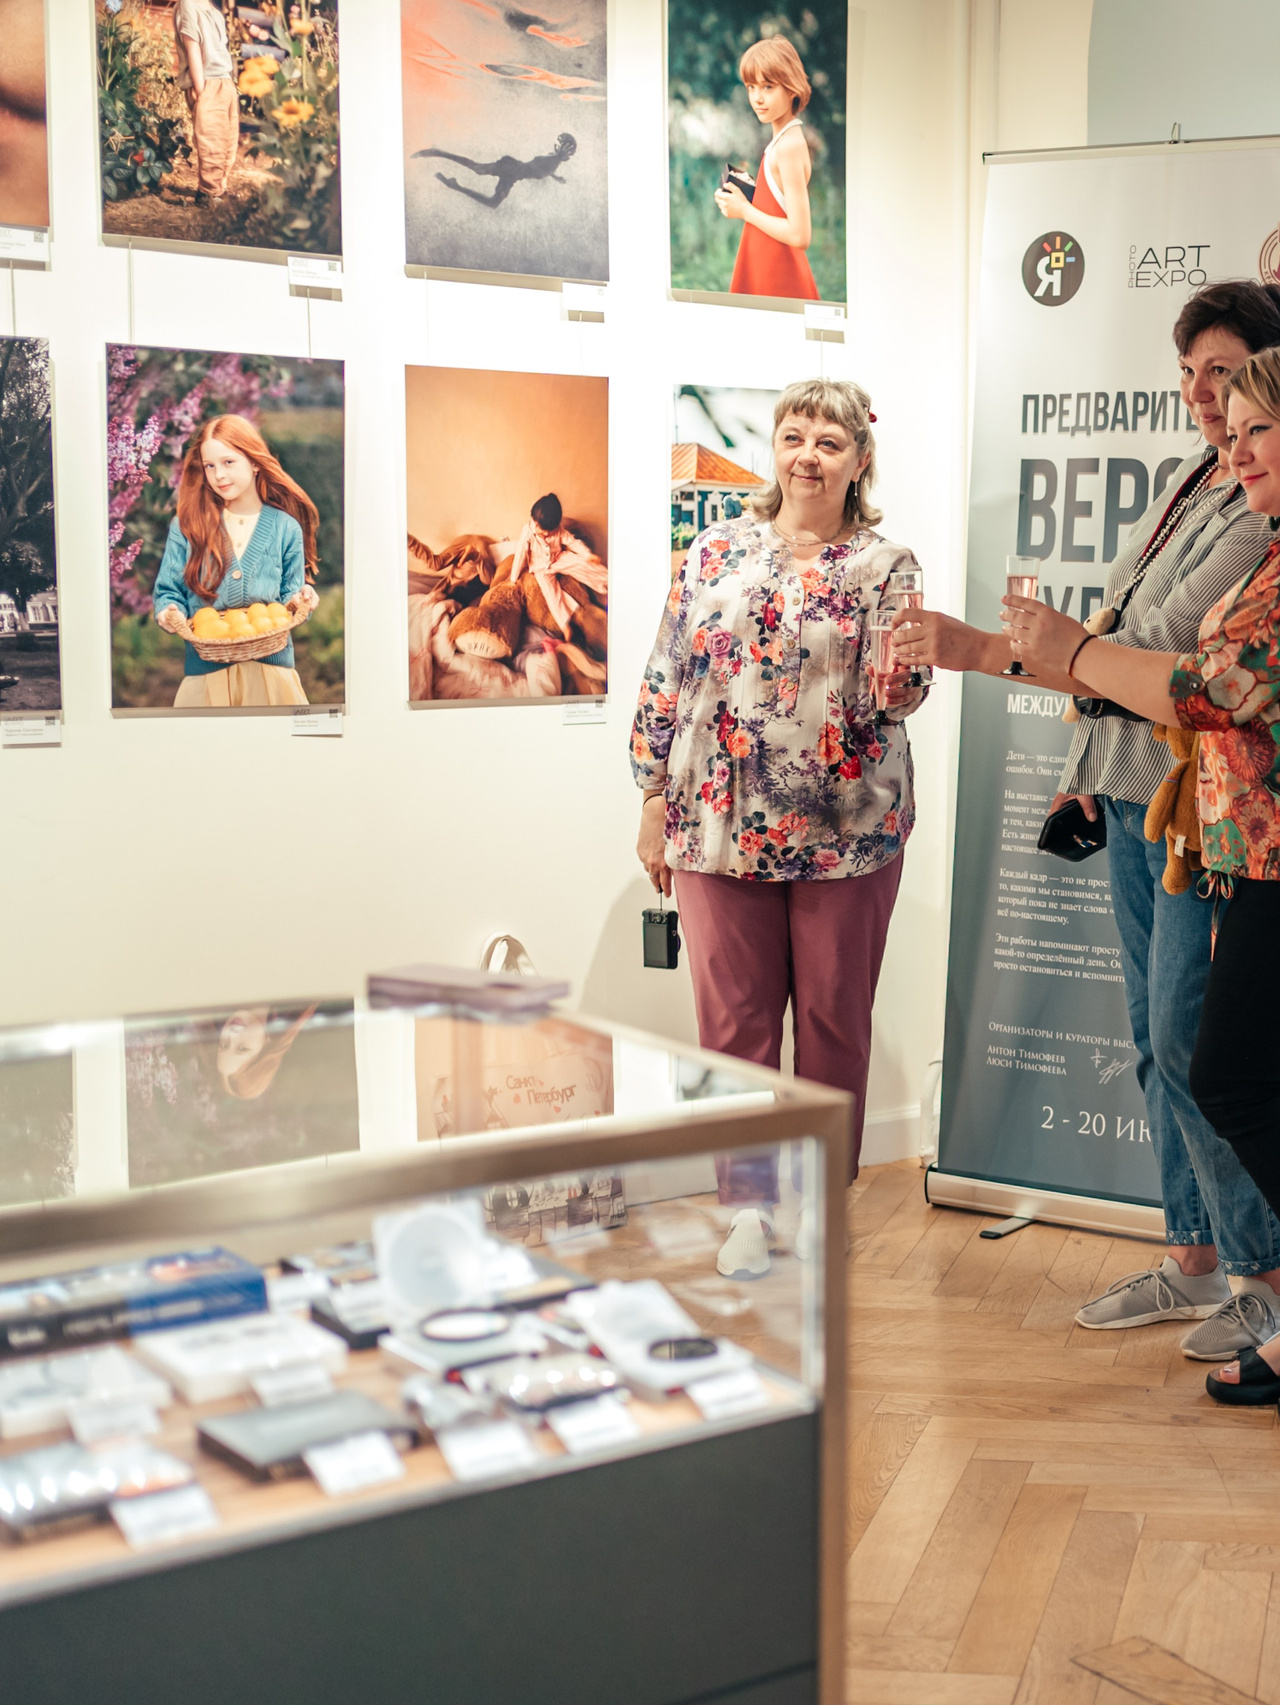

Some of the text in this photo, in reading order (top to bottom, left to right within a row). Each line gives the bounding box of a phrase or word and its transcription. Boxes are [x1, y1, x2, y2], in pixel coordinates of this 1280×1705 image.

[1128, 245, 1137, 288] PHOTO
[1137, 245, 1211, 270] ART
[1135, 269, 1207, 288] EXPO
[1006, 750, 1025, 761] Дети
[1036, 754, 1048, 762] это
[1006, 765, 1035, 775] ошибок.
[1037, 766, 1052, 776] Они
[1004, 789, 1015, 799] На
[1004, 805, 1030, 814] момент
[1002, 828, 1018, 839] Есть
[1000, 868, 1028, 880] Каждый
[1030, 872, 1047, 884] кадр
[1061, 876, 1074, 884] это
[1076, 877, 1086, 886] не
[999, 882, 1009, 891] то,
[1010, 883, 1036, 894] какими
[1038, 886, 1050, 896] мы
[1052, 887, 1102, 901] становимся,
[998, 895, 1027, 907] который
[1028, 897, 1047, 909] пока
[1048, 900, 1058, 909] не
[1060, 901, 1082, 912] знает
[1083, 904, 1107, 914] слова
[1010, 909, 1069, 925] по-настоящему.
[995, 932, 1009, 943] Эти
[1010, 934, 1037, 947] работы
[1039, 940, 1090, 953] напоминают
[994, 947, 1025, 959] какой-то
[1026, 950, 1085, 966] определённый
[1086, 958, 1108, 968] день.
[993, 960, 1018, 971] просто
[1019, 962, 1073, 978] остановиться
[988, 1021, 1053, 1039] ОРГАНИЗАТОРЫ
[1056, 1032, 1063, 1041] И
[1065, 1032, 1110, 1046] КУРАТОРЫ
[986, 1044, 1066, 1064] АНТОН ТИМОФЕЕВ
[986, 1056, 1067, 1076] ЛЮСИ ТИМОФЕЕВА
[1041, 1105, 1055, 1130] 2
[1077, 1110, 1106, 1137] 20
